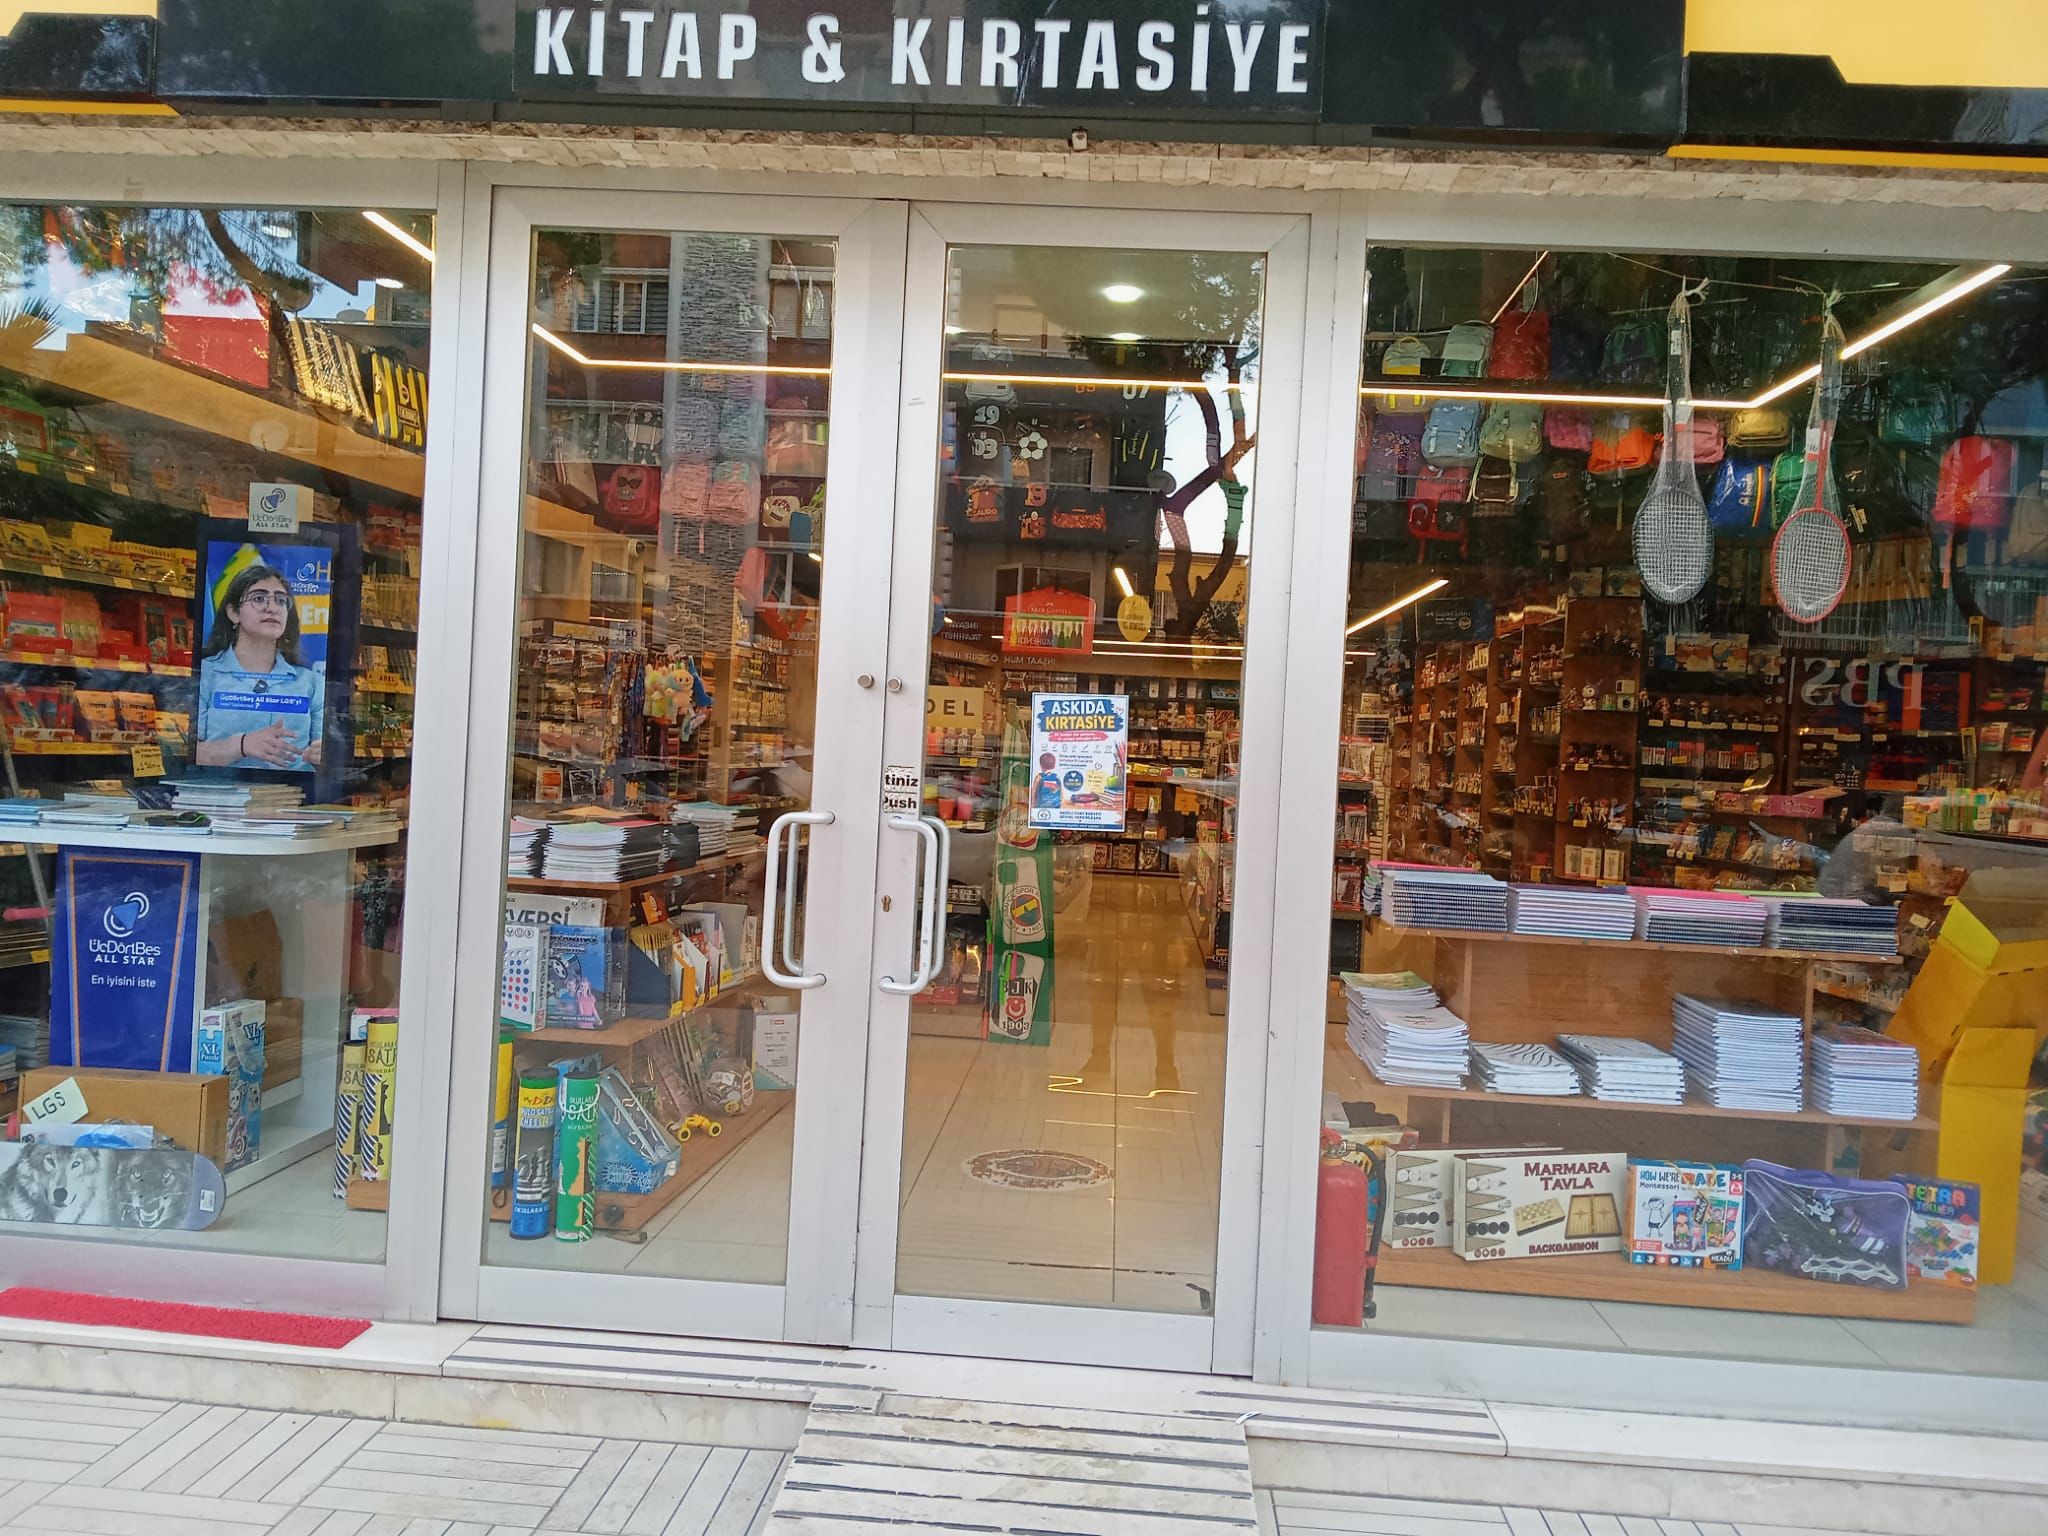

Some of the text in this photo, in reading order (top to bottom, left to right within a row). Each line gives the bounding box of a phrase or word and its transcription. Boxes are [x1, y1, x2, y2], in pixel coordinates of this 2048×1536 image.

[533, 0, 1311, 93] KİTAP & KIRTASİYE
[974, 405, 1000, 425] 19
[1051, 700, 1106, 715] ASKIDA
[1045, 715, 1115, 730] KIRTASİYE
[94, 954, 155, 966] ALL STAR
[91, 974, 156, 988] En iyisini iste
[1002, 1021, 1030, 1032] 1903
[31, 1091, 66, 1119] LGS
[1524, 1161, 1611, 1177] MARMARA
[1540, 1177, 1595, 1191] TAVLA
[1639, 1182, 1680, 1190] Montessori
[1640, 1170, 1657, 1181] HOW
[1681, 1172, 1727, 1188] MADE
[1907, 1184, 1967, 1208] TETRA
[1528, 1240, 1600, 1255] BACKGAMMON
